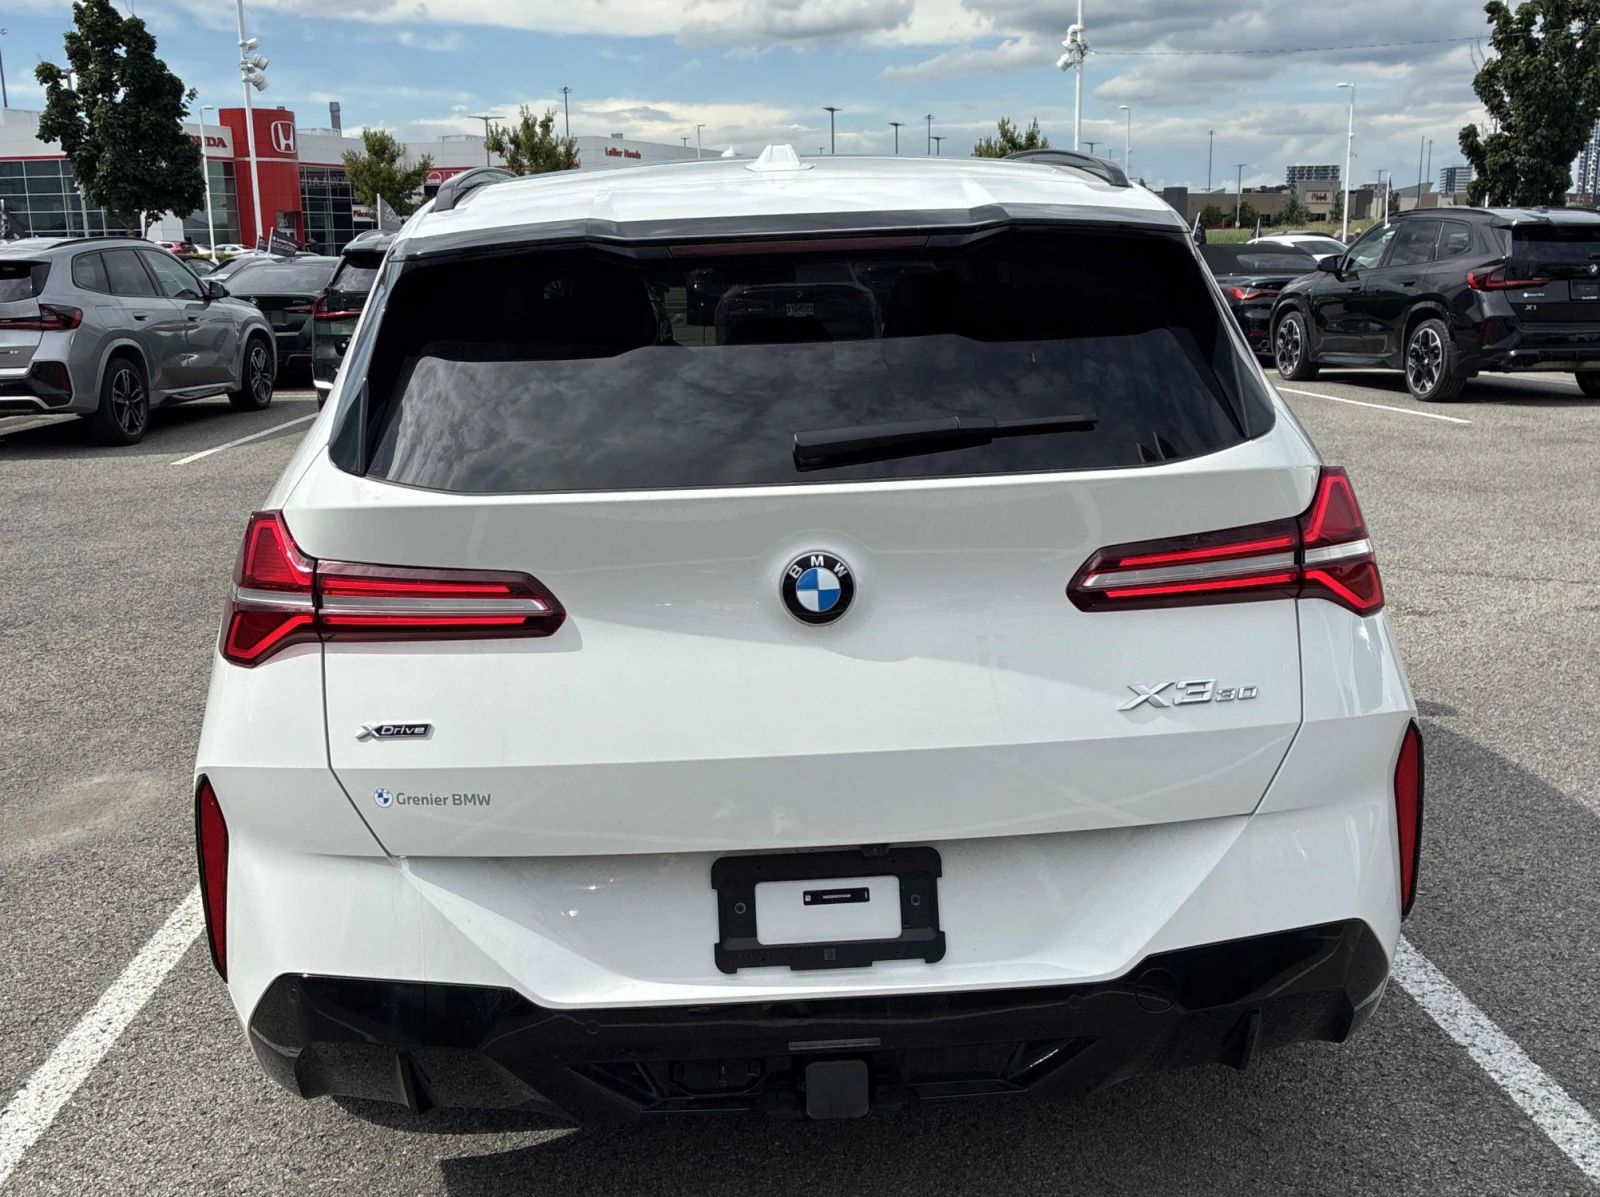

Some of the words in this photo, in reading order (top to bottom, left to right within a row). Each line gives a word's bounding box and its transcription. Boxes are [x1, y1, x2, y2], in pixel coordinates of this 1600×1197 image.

[788, 555, 848, 579] BMW
[396, 792, 449, 806] Grenier
[451, 793, 491, 806] BMW
